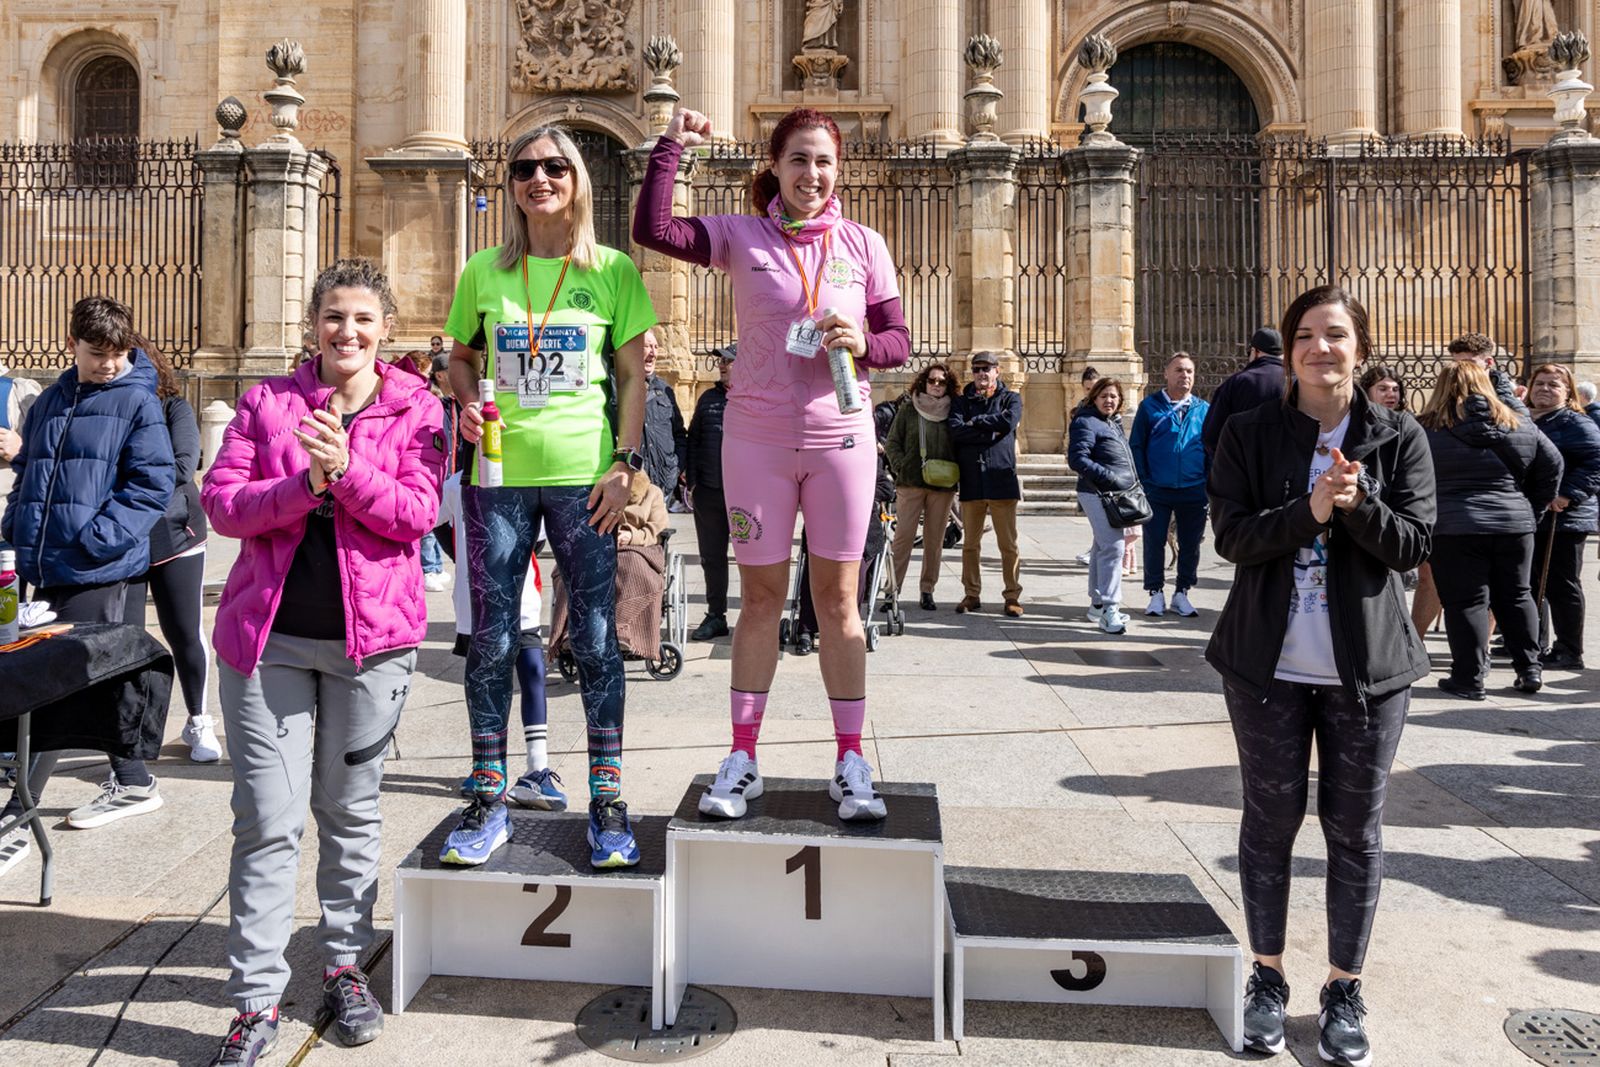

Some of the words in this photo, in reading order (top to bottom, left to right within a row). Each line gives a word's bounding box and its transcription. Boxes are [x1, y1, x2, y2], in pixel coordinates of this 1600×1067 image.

[506, 338, 529, 349] BUENA
[539, 338, 562, 349] UERTE
[517, 352, 565, 376] 102
[785, 846, 821, 920] 1
[520, 883, 572, 948] 2
[1049, 950, 1107, 992] 3
